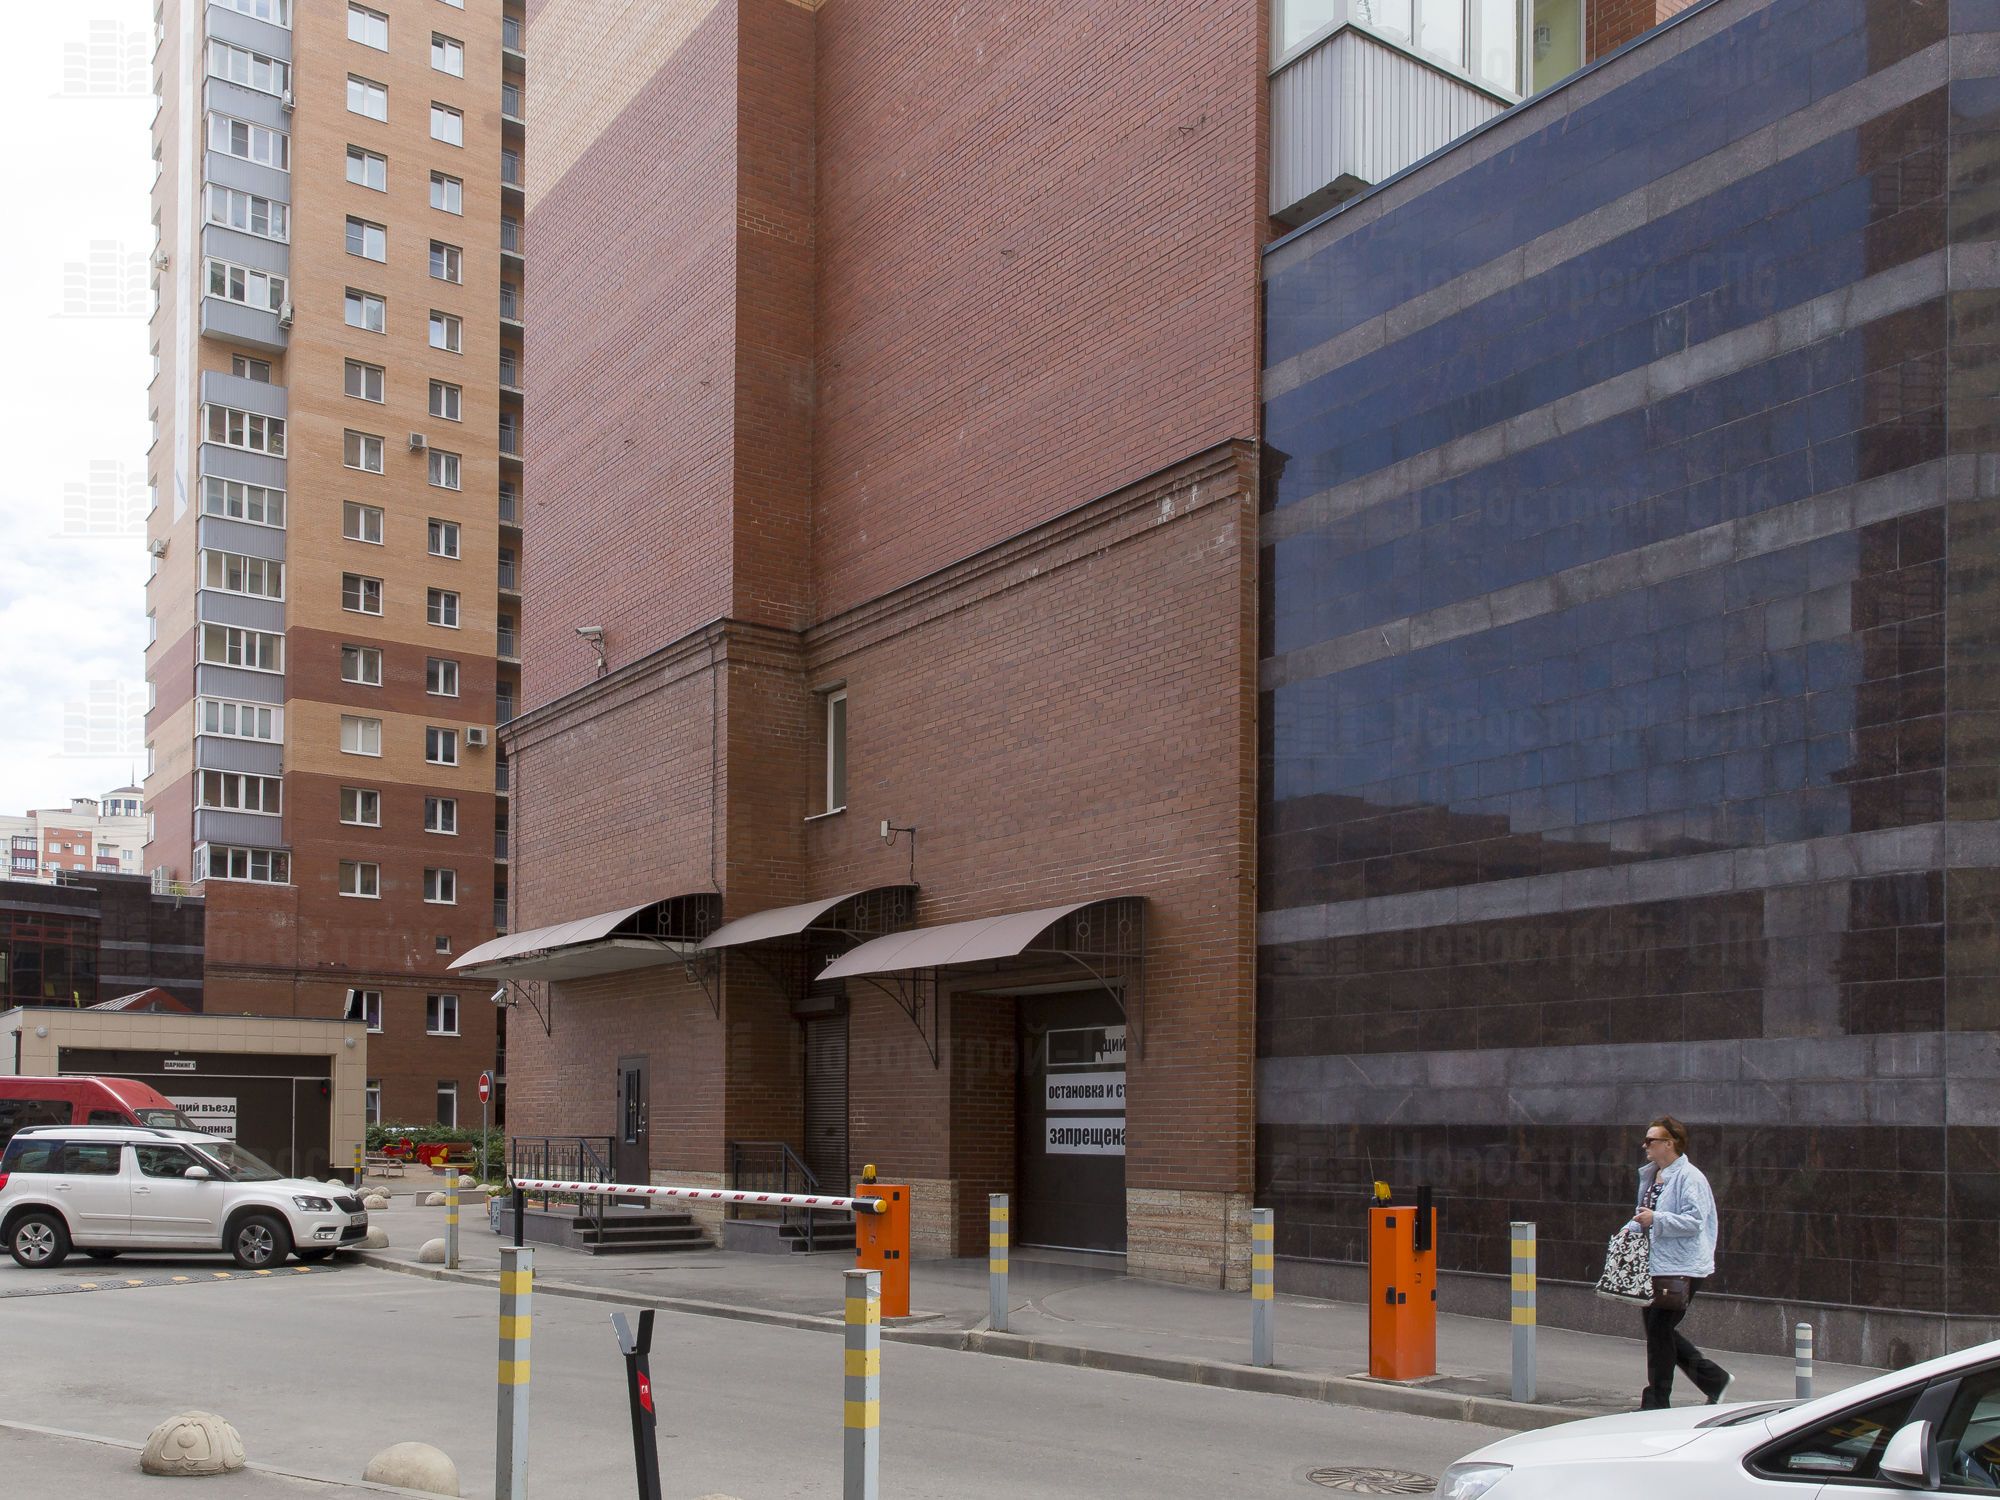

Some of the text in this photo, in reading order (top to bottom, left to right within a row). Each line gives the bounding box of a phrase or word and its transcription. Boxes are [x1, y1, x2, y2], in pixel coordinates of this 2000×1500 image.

[1048, 1085, 1104, 1099] остановка
[1106, 1084, 1114, 1098] и
[201, 1104, 236, 1113] въезд
[1049, 1127, 1126, 1149] запрещена
